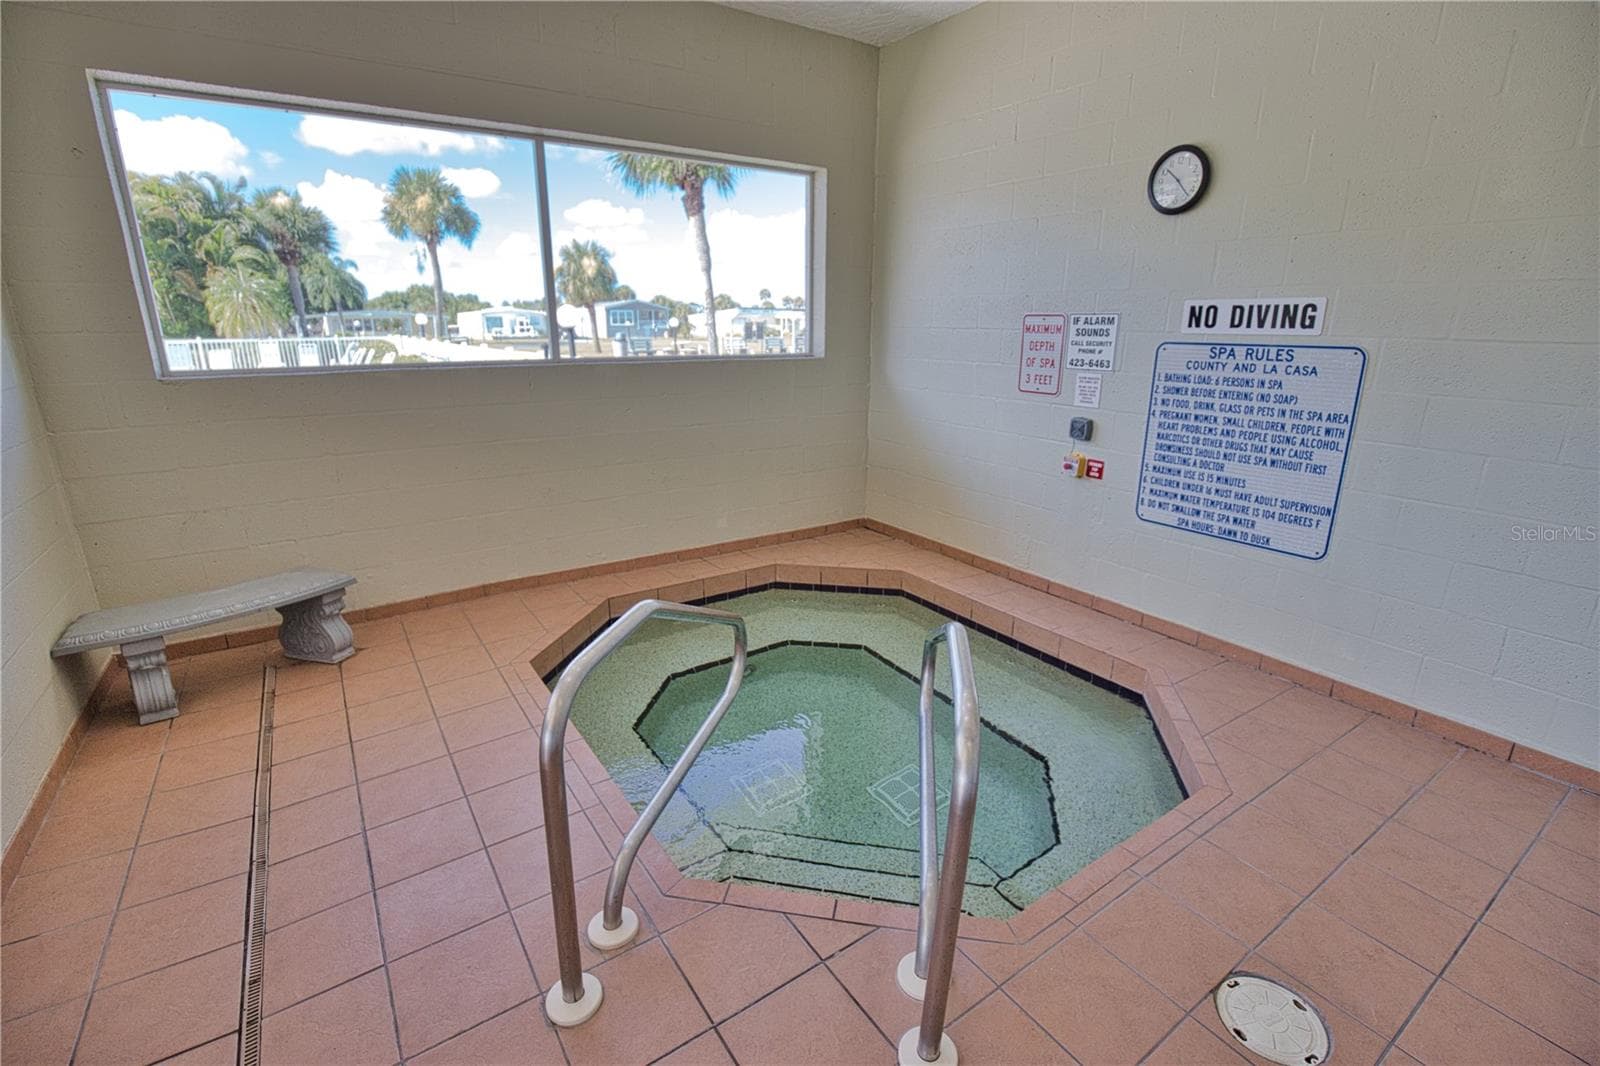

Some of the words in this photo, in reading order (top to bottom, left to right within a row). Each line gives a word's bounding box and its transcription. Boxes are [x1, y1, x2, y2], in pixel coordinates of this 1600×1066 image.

[1073, 317, 1081, 325] IF
[1083, 317, 1115, 325] ALARM
[1188, 305, 1218, 328] NO
[1229, 303, 1317, 329] DIVING
[1025, 325, 1062, 334] MAXIMUM
[1075, 328, 1110, 337] SOUNDS
[1029, 341, 1055, 351] DEPTH
[1209, 346, 1236, 360] SPA
[1245, 348, 1294, 362] RULES
[1026, 357, 1036, 367] OF
[1040, 358, 1055, 368] SPA
[1069, 359, 1110, 368] 423-6463
[1186, 360, 1227, 371] COUNTY
[1232, 362, 1256, 373] AND
[1263, 364, 1277, 374] LA
[1284, 365, 1317, 376] CASA
[1025, 374, 1030, 383] 3
[1034, 374, 1052, 385] FEET
[1164, 373, 1191, 383] BATHING
[1215, 377, 1219, 385] 6
[1222, 376, 1255, 388] PERSONS
[1257, 379, 1265, 388] IN
[1267, 379, 1282, 389] SPA
[1162, 385, 1188, 395] SHOWER
[1190, 387, 1216, 398] BEFORE
[1218, 390, 1253, 401] ENTERING
[1256, 393, 1271, 403] (NO
[1273, 394, 1298, 405] SOAP)
[1161, 398, 1170, 406] NO
[1219, 403, 1242, 414] GLASS
[1244, 405, 1254, 415] OR
[1256, 406, 1274, 417] PETS
[1277, 408, 1286, 418] IN
[1289, 409, 1304, 420] THE
[1306, 410, 1322, 421] SPA
[1325, 413, 1348, 424] AREA
[1158, 421, 1178, 431] HEART
[1180, 423, 1217, 436] PROBLEMS
[1219, 428, 1236, 438] AND
[1238, 430, 1268, 442] PEOPLE
[1271, 434, 1296, 446] USING
[1159, 410, 1192, 421] PREGNANT
[1222, 416, 1244, 427] SMALL
[1290, 423, 1322, 436] PEOPLE
[1324, 427, 1345, 438] WITH
[1156, 432, 1189, 444] NARCOTICS
[1191, 436, 1200, 445] OR
[1202, 437, 1222, 448] OTHER
[1224, 440, 1248, 452] DRUGS
[1250, 443, 1267, 454] THAT
[1269, 446, 1286, 456] MAY
[1288, 448, 1314, 461] CAUSE
[1154, 453, 1190, 466] CONSULTING
[1192, 459, 1197, 467] A
[1199, 459, 1224, 471] DOCTOR
[1155, 442, 1192, 455] DROWSINESS
[1194, 448, 1220, 459] SHOULD
[1222, 452, 1236, 461] NOT
[1238, 454, 1251, 464] USE
[1253, 456, 1267, 466] SPA
[1270, 458, 1302, 472] WITHOUT
[1304, 463, 1327, 475] FIRST
[1152, 465, 1181, 476] MAXIMUM
[1183, 470, 1196, 479] USE
[1198, 472, 1204, 481] IS
[1206, 473, 1213, 482] 15
[1215, 475, 1246, 488] MINUTES
[1150, 476, 1180, 488] CHILDREN
[1182, 482, 1204, 493] UNDER
[1206, 486, 1212, 495] 16
[1214, 488, 1232, 498] MUST
[1234, 492, 1252, 502] HAVE
[1254, 495, 1278, 507] ADULT
[1279, 499, 1332, 517] SUPERVISION
[1148, 499, 1156, 508] DO
[1158, 501, 1169, 510] NOT
[1171, 504, 1201, 517] SWALLOW
[1203, 510, 1215, 521] THE
[1217, 513, 1230, 523] SPA
[1232, 516, 1256, 529] WATER
[1149, 488, 1178, 500] MAXIMUM
[1180, 494, 1200, 505] WATER
[1203, 498, 1250, 515] TEMPERATURE
[1252, 508, 1259, 517] IS
[1262, 509, 1275, 520] 104
[1278, 512, 1313, 527] DEGREES
[1315, 519, 1321, 528] F
[1177, 517, 1188, 527] SPA
[1218, 526, 1237, 538] DAWN
[1240, 531, 1248, 541] TO
[1250, 534, 1270, 546] DUSK
